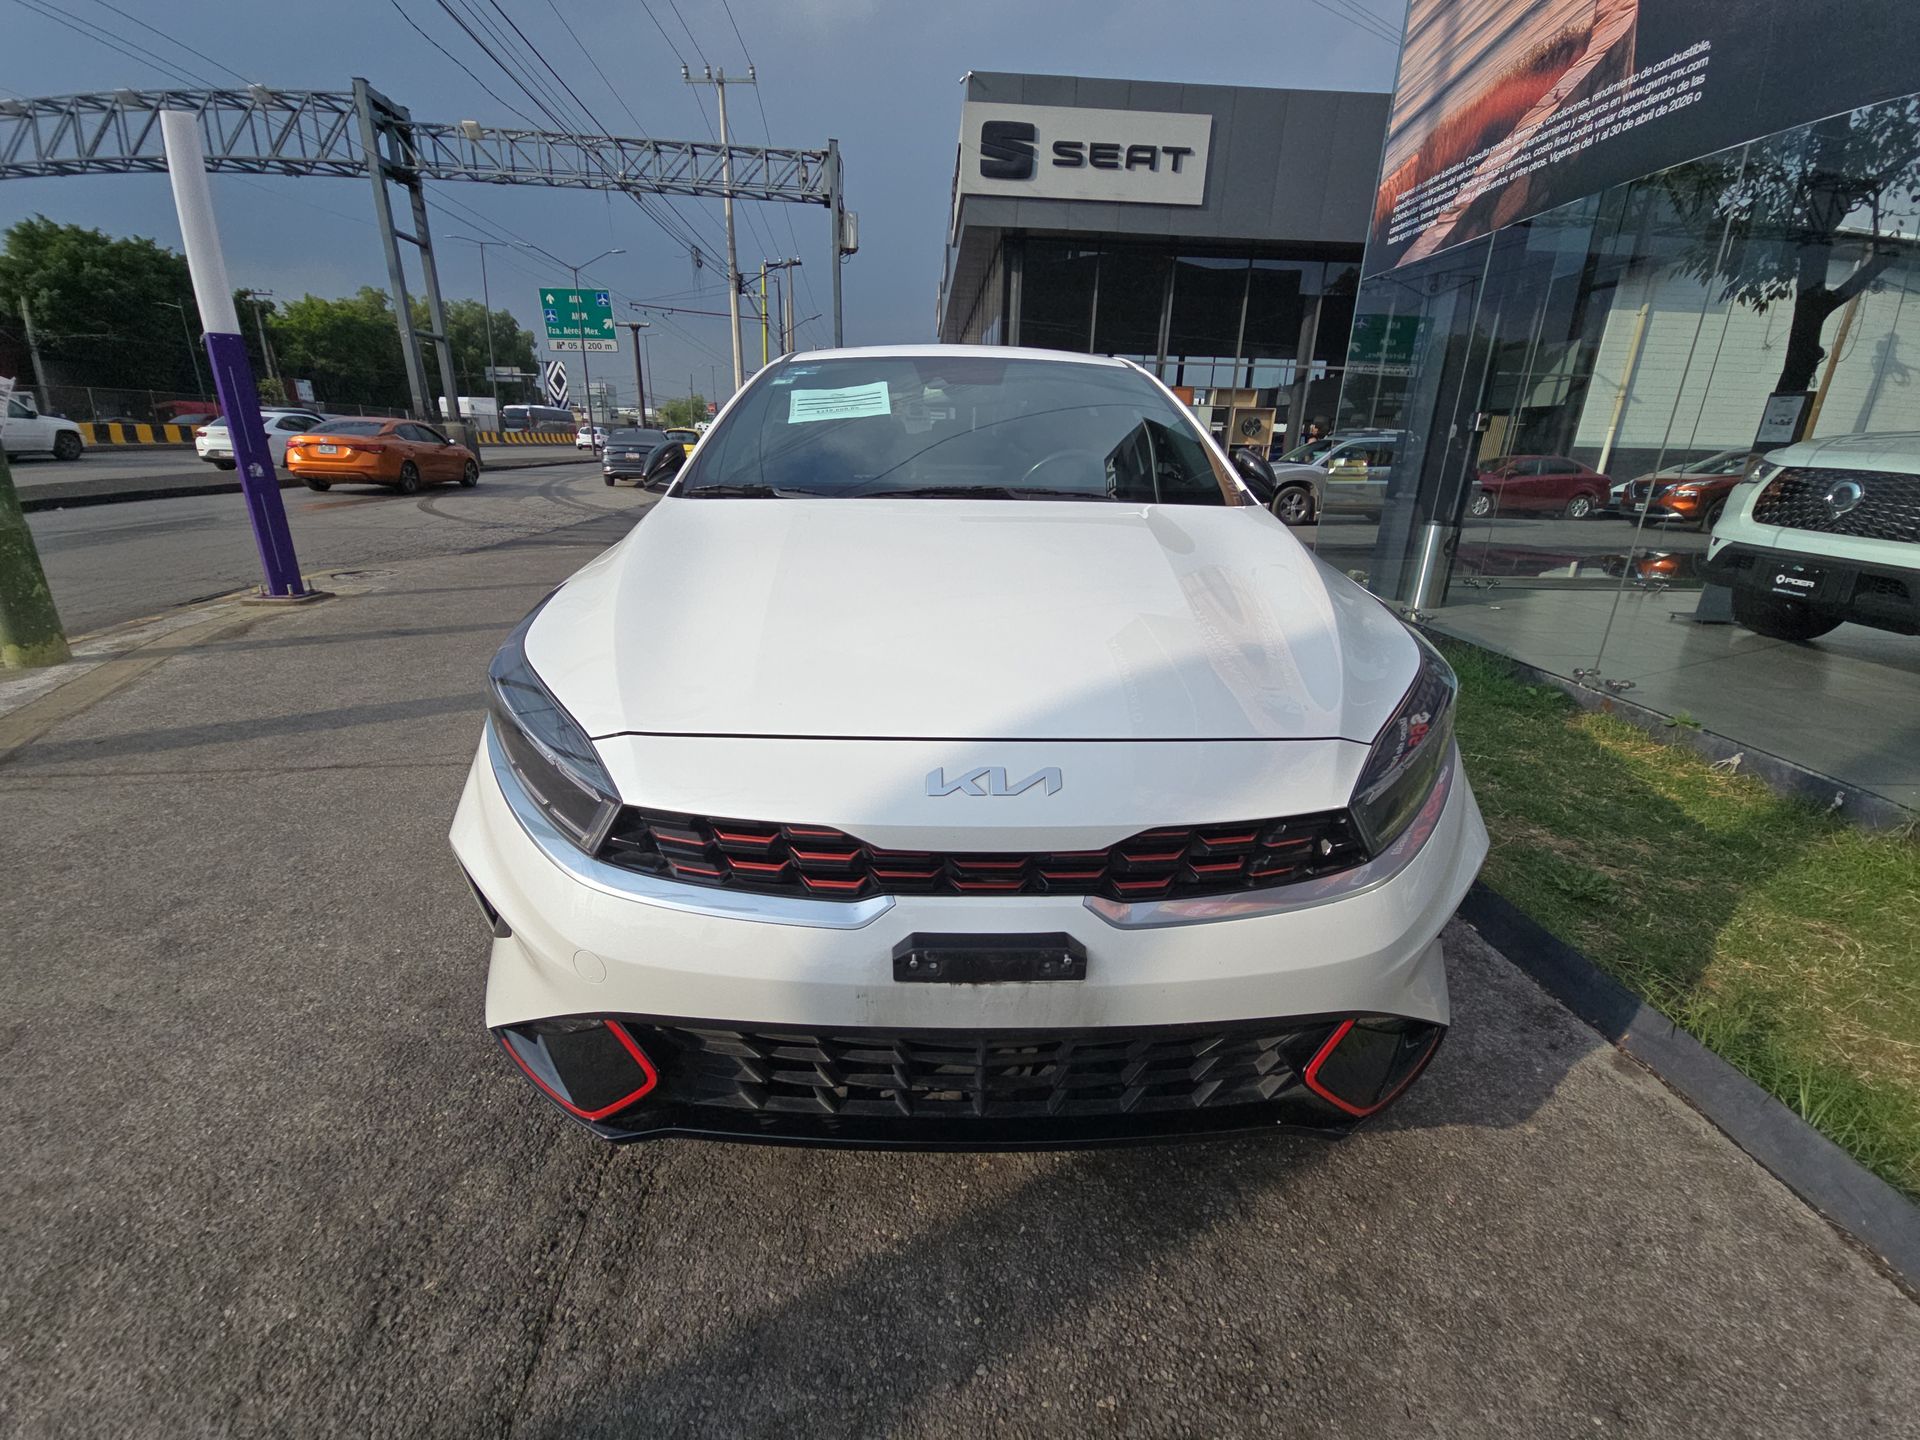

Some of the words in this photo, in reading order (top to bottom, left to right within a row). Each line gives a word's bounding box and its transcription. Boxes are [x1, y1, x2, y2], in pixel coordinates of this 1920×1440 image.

[1522, 120, 1570, 149] financiamiento
[1578, 101, 1609, 122] seguros
[1610, 96, 1621, 107] en
[1622, 56, 1709, 102] www.gwm-mx.com
[1546, 99, 1589, 125] condiciones,
[1592, 72, 1640, 102] rendimiento
[1641, 66, 1652, 78] de
[1654, 41, 1711, 72] combustible,
[1533, 142, 1553, 157] costo
[1554, 132, 1570, 147] final
[1594, 112, 1616, 129] variar
[1618, 86, 1675, 118] dependiendo
[1677, 80, 1690, 93] de
[1691, 73, 1706, 87] las
[1549, 142, 1580, 162] Vigencia
[1581, 135, 1593, 148] del
[1601, 128, 1609, 139] al
[1610, 123, 1621, 136] 30
[1622, 119, 1634, 130] de
[1635, 109, 1654, 125] abril
[1656, 105, 1668, 117] de
[1052, 140, 1192, 172] SEAT
[584, 327, 601, 336] Mex.
[925, 766, 1064, 798] KIA
